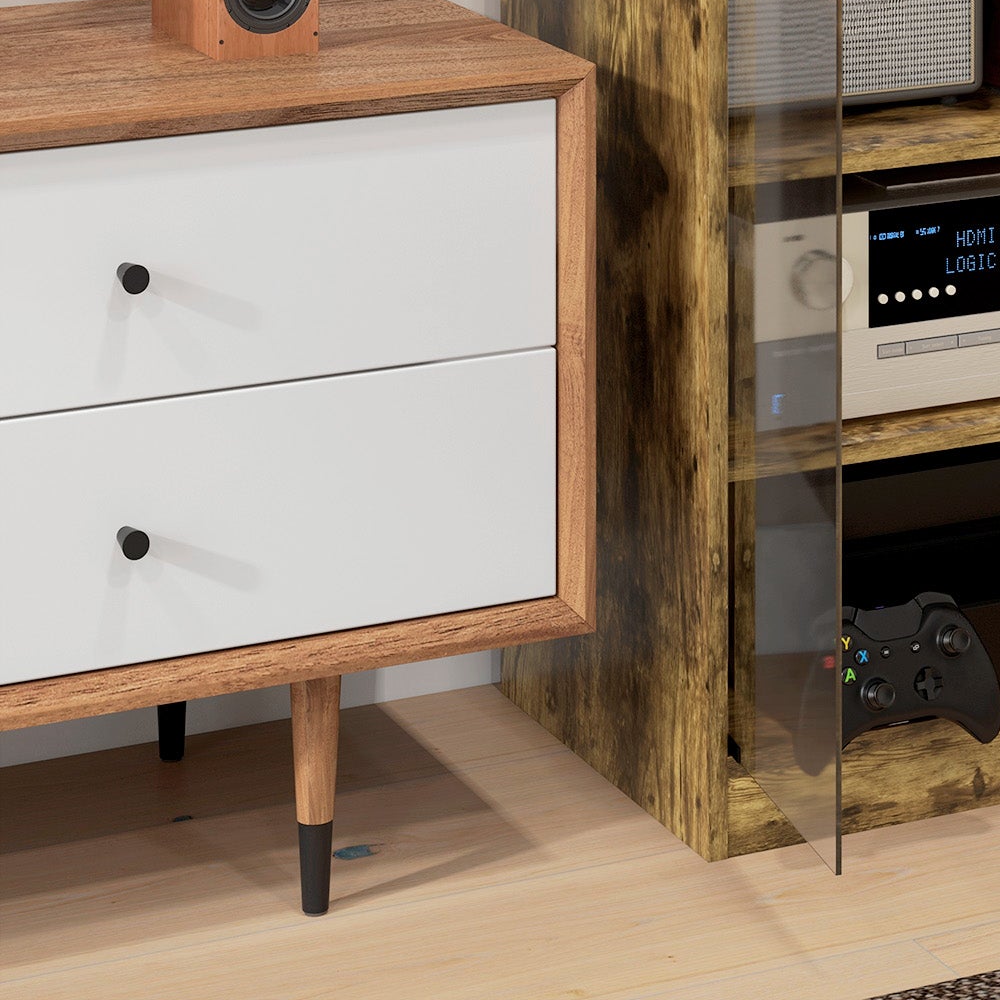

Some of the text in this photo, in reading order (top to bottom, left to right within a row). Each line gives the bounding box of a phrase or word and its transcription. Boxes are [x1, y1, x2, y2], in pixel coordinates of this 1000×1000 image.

[957, 227, 994, 247] HDMI
[946, 253, 996, 274] LOGIC
[840, 636, 851, 650] Y
[857, 649, 869, 664] X
[844, 667, 857, 683] A
